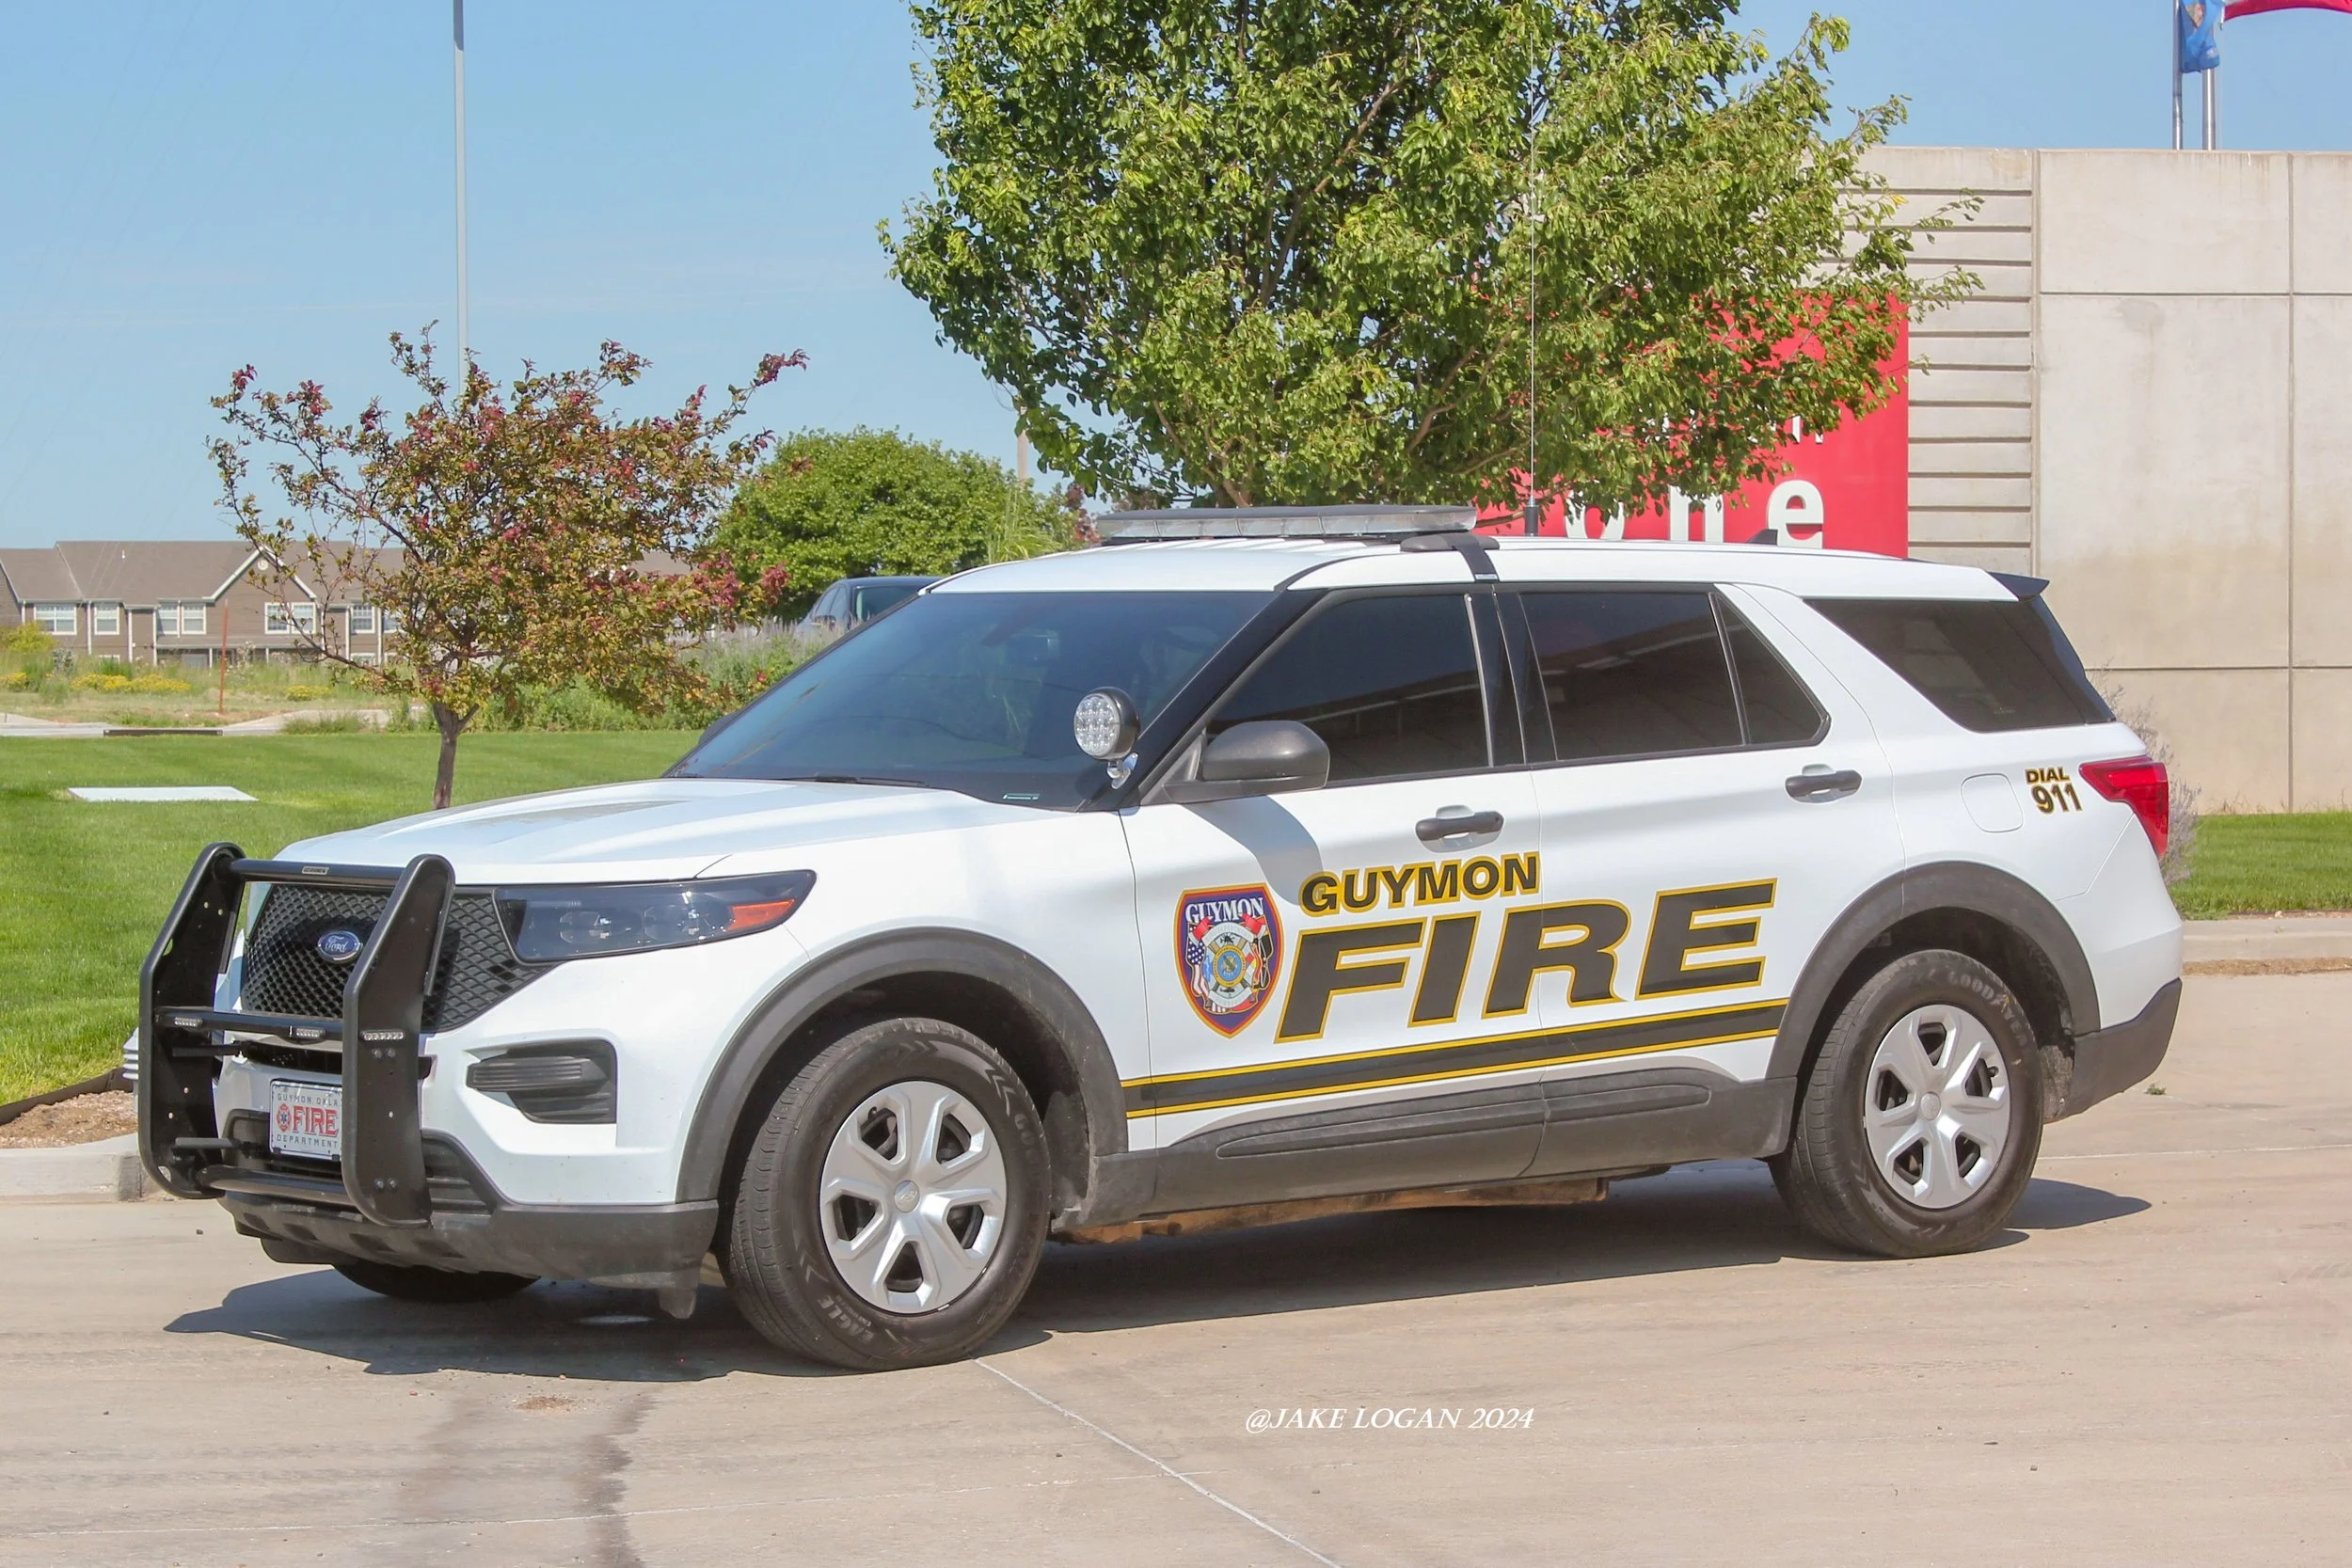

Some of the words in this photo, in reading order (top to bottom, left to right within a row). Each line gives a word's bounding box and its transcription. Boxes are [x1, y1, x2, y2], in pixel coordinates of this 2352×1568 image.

[2025, 766, 2071, 784] DIAL
[2031, 782, 2083, 815] 911
[1298, 851, 1540, 918] GUYMON
[1185, 896, 1263, 924] GUYMON
[325, 935, 349, 953] Ford
[1274, 878, 1778, 1044] FIRE
[293, 1105, 340, 1137] FIRE
[277, 1134, 338, 1148] DEPARTMENT
